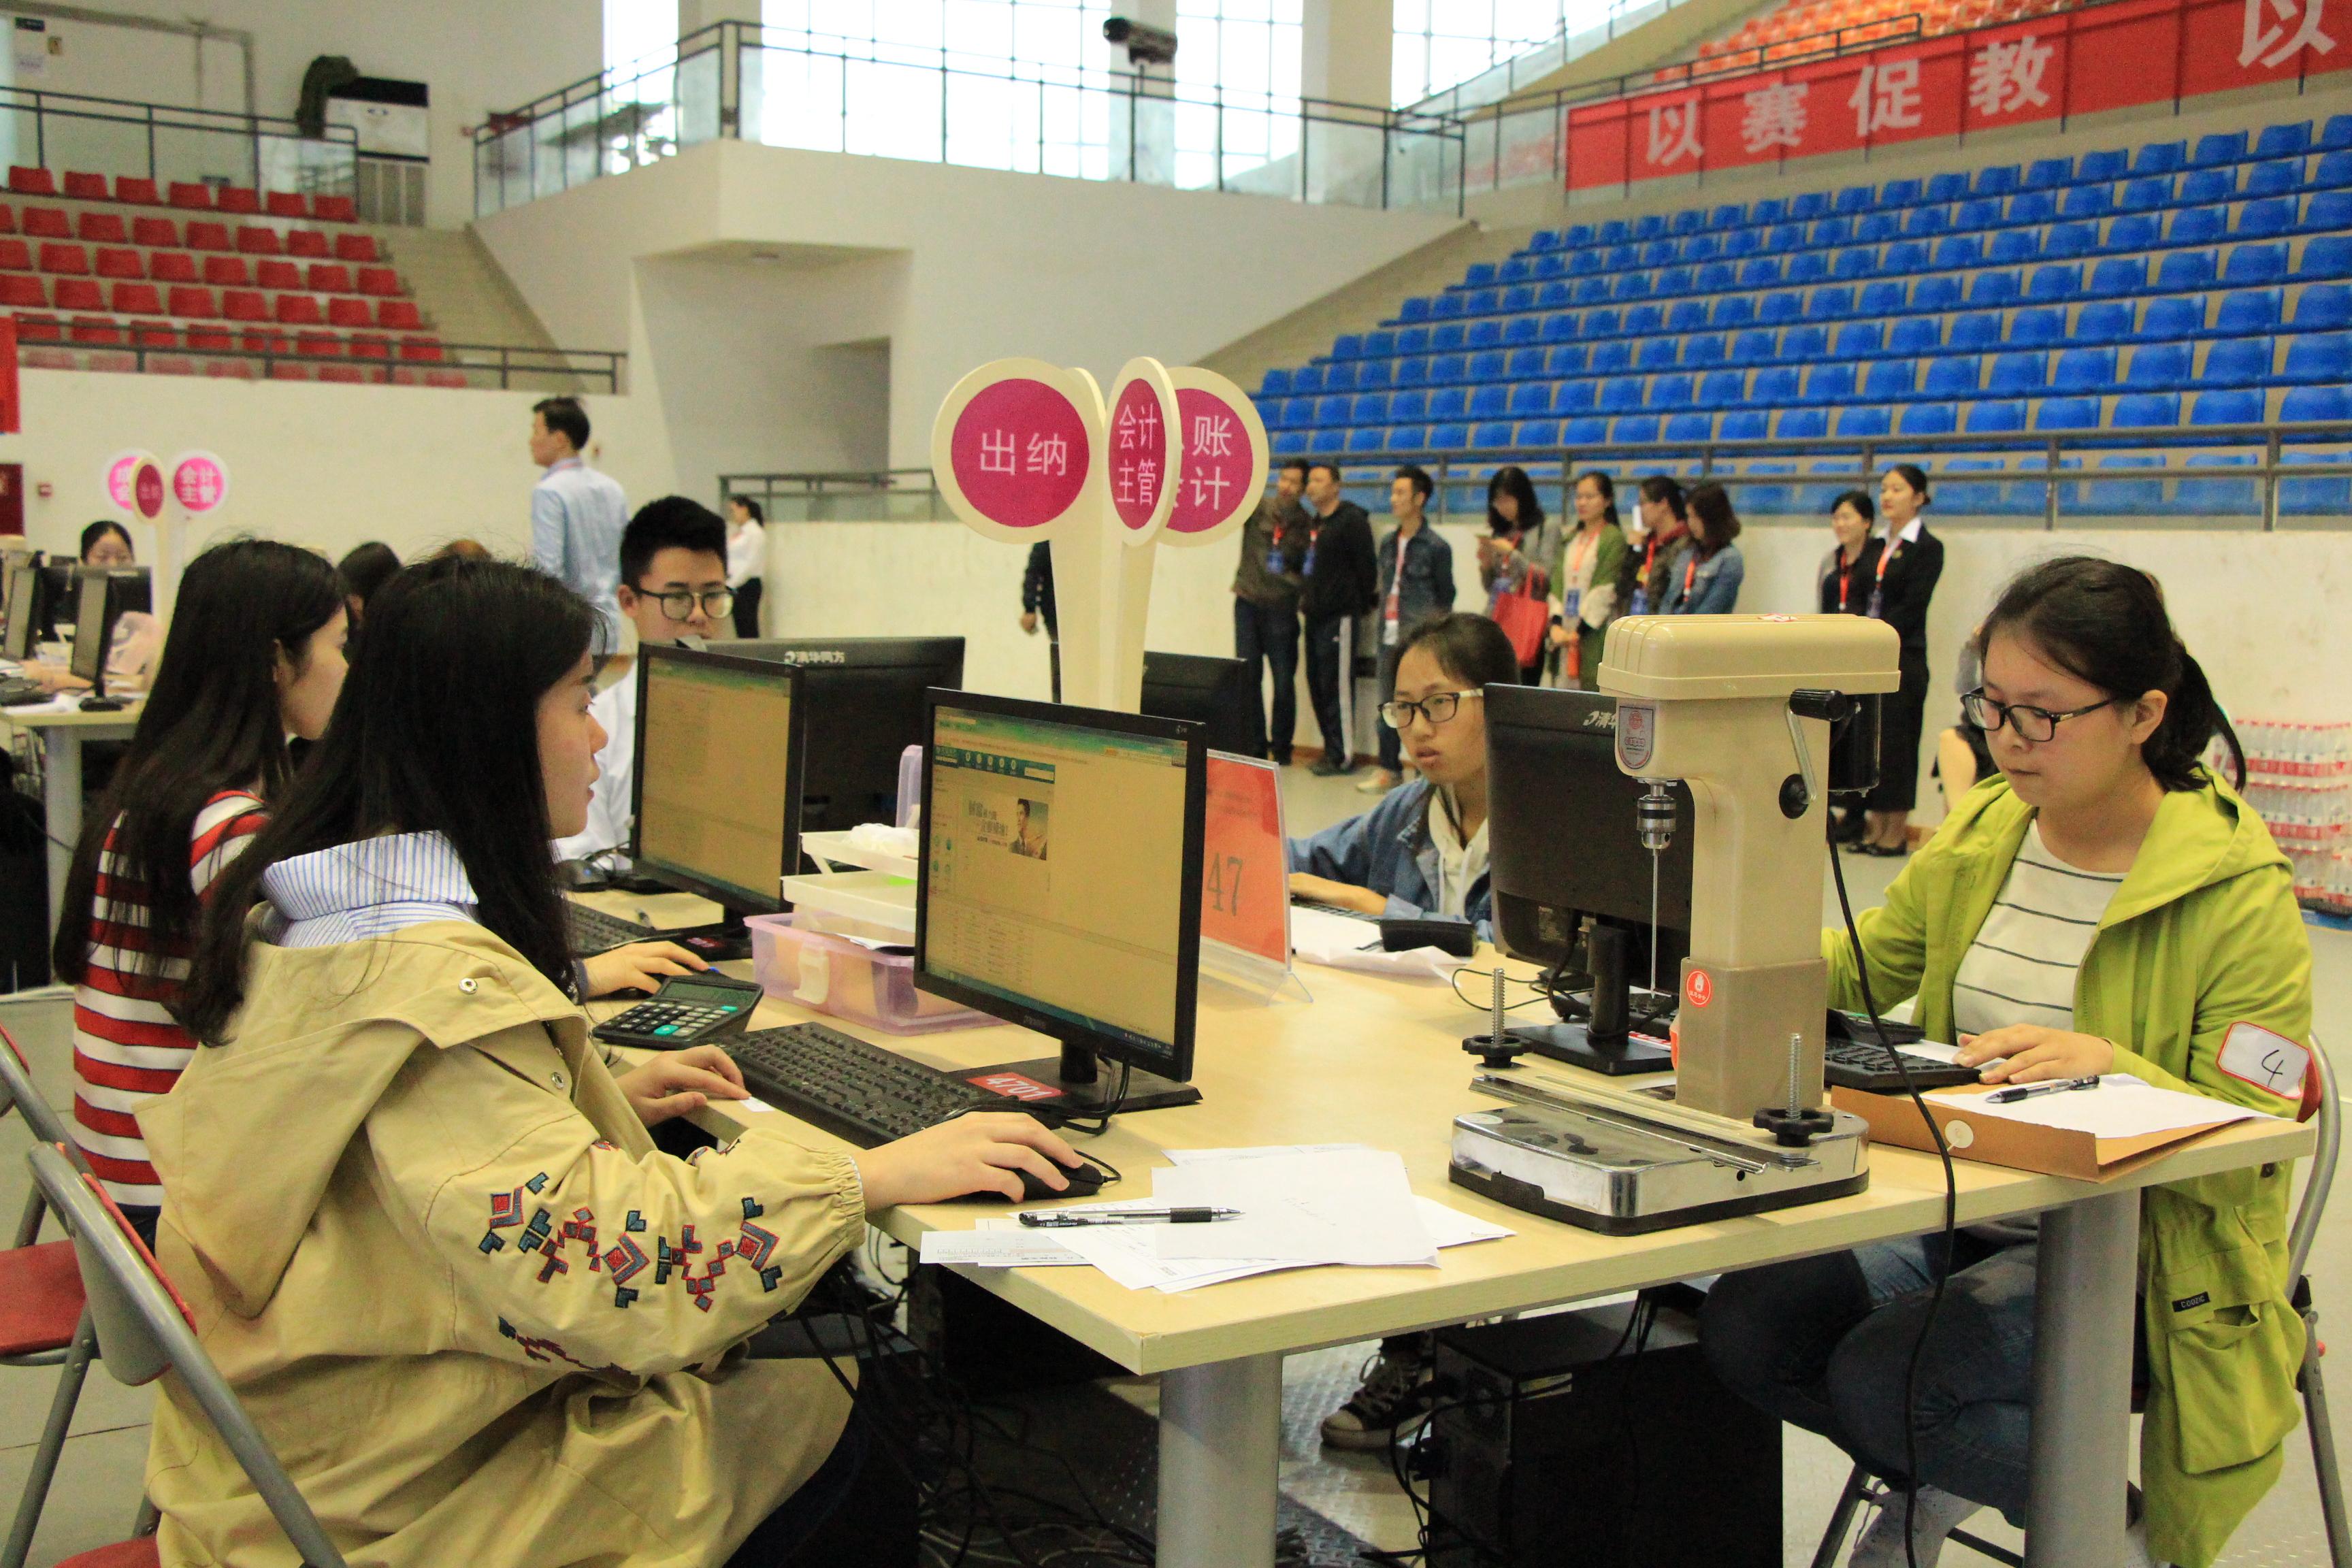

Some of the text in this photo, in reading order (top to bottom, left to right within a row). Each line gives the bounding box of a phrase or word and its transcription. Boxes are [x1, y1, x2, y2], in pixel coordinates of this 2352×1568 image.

[1645, 35, 2054, 166] 以赛促教
[1117, 403, 1158, 450] 会计
[1181, 414, 1232, 458] 账
[979, 428, 1068, 476] 出纳
[1117, 457, 1157, 506] 主管
[1173, 466, 1230, 510] 计
[1207, 852, 1243, 916] 47
[986, 1077, 1053, 1098] 4701
[2261, 1049, 2284, 1088] 4
